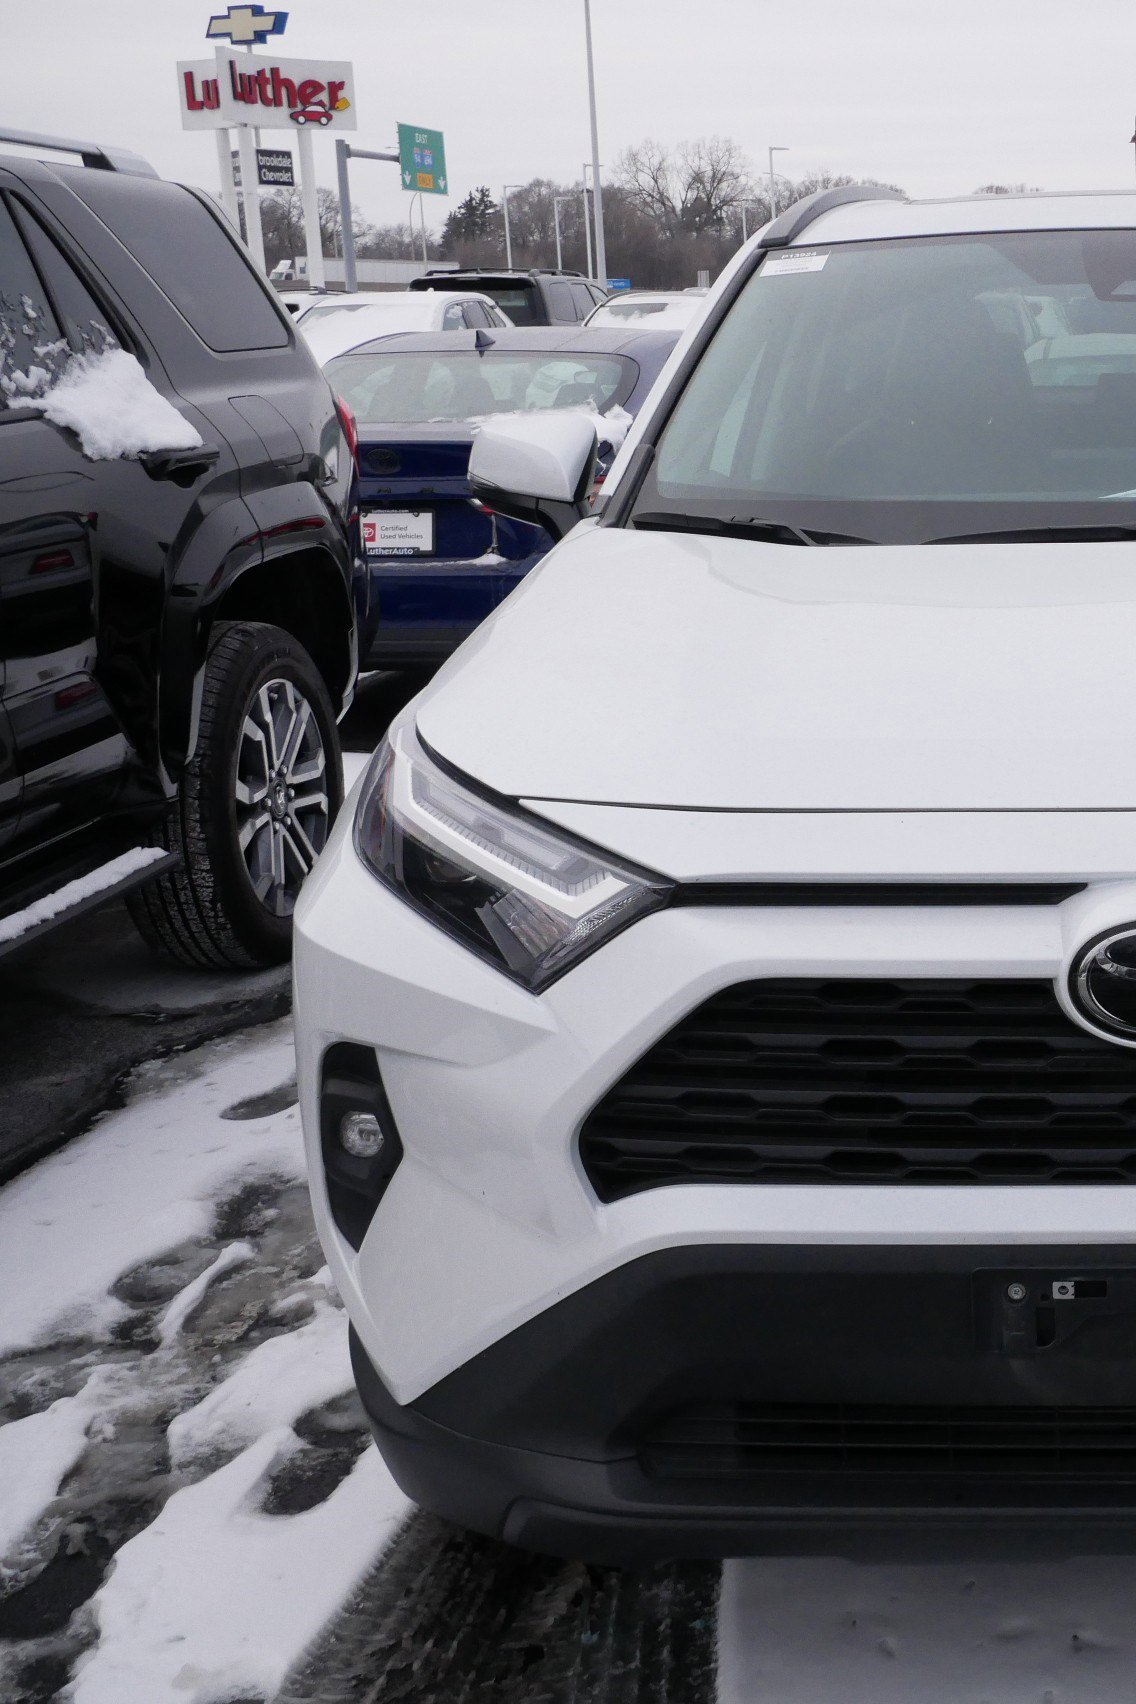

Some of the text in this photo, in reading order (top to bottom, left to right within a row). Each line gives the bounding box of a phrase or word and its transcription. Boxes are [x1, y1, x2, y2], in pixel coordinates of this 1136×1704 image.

[229, 60, 346, 110] Luther
[258, 153, 292, 167] brookdale
[261, 169, 293, 183] Chevrolet
